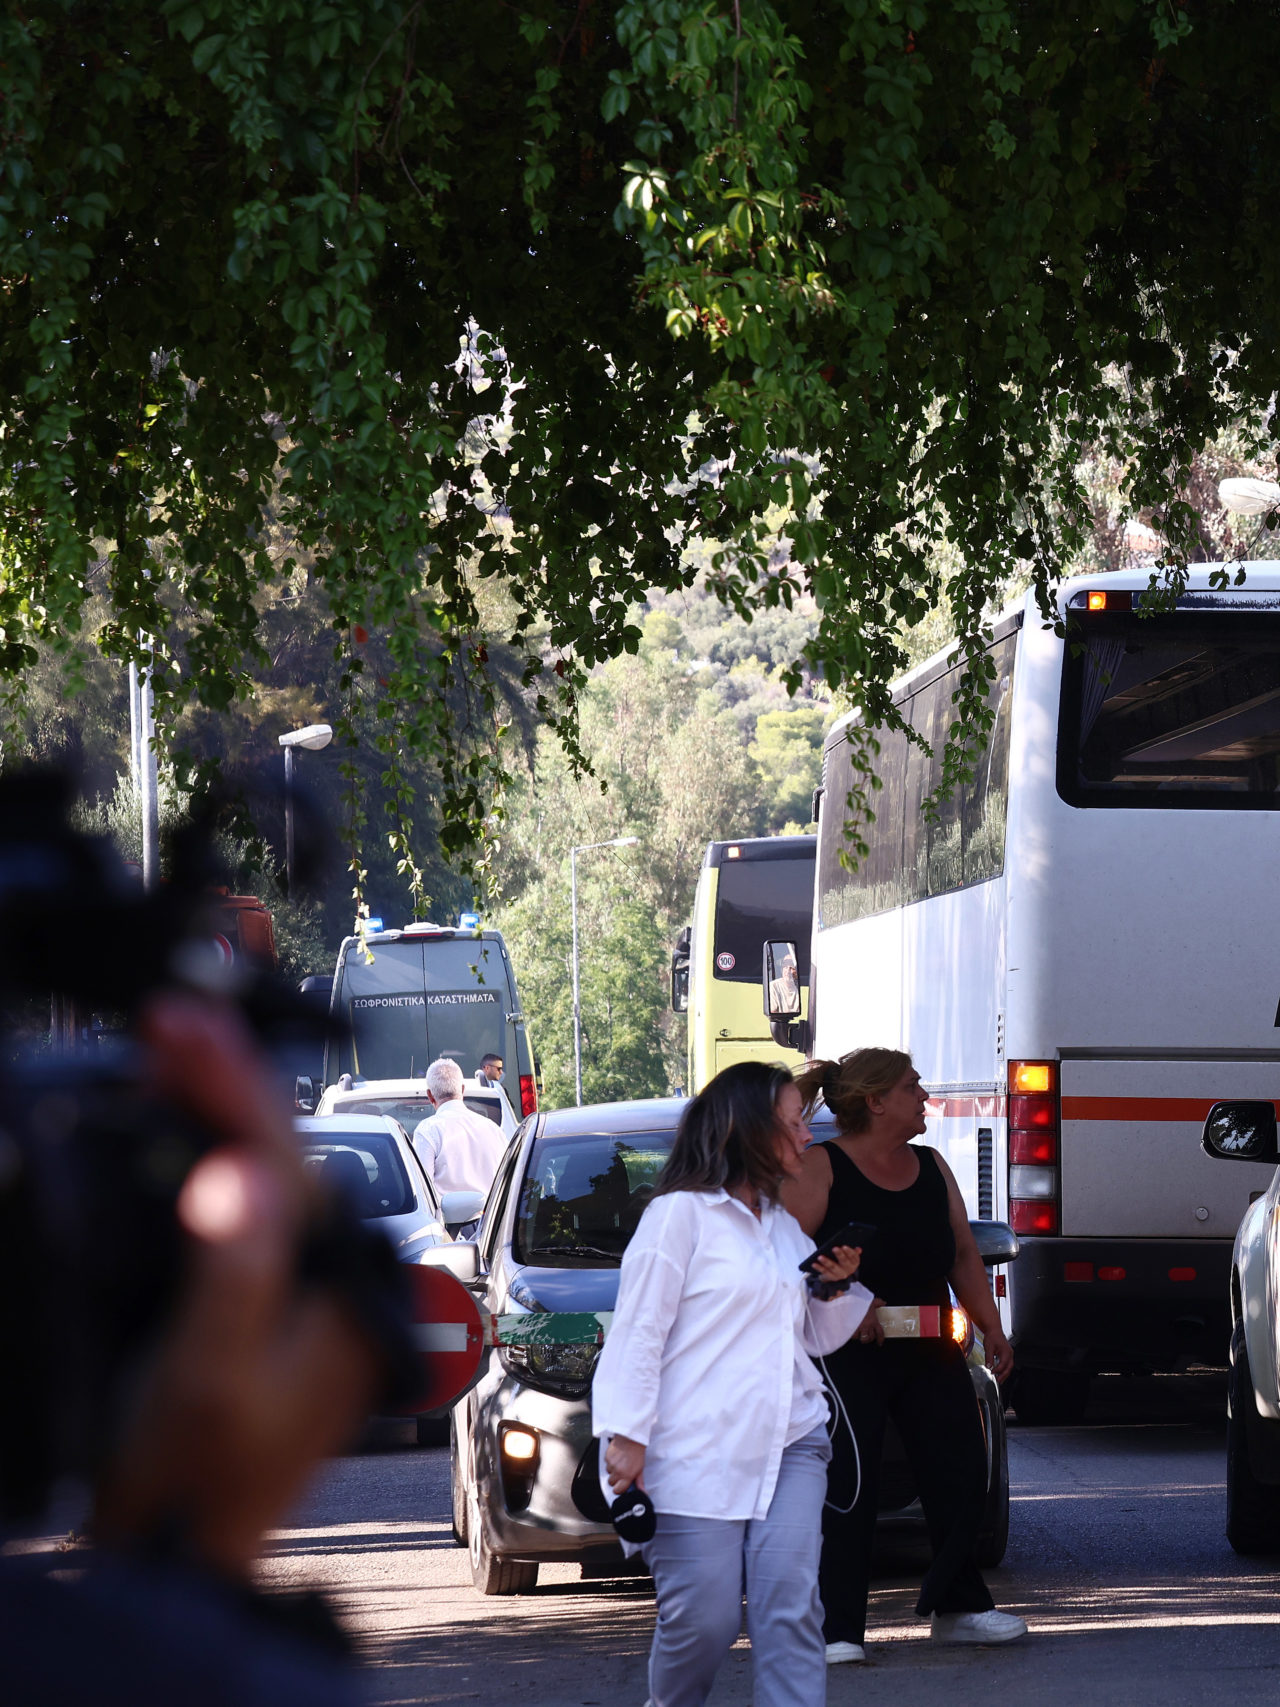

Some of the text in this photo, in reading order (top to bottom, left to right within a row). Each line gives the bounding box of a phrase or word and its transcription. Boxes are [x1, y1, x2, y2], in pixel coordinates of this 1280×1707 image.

[720, 957, 732, 966] 100
[354, 993, 495, 1008] ΣΩΦΡΟΝΙΣΤΙΚΑ ΚΑΤΑΣΤΗΜΑΤΑ
